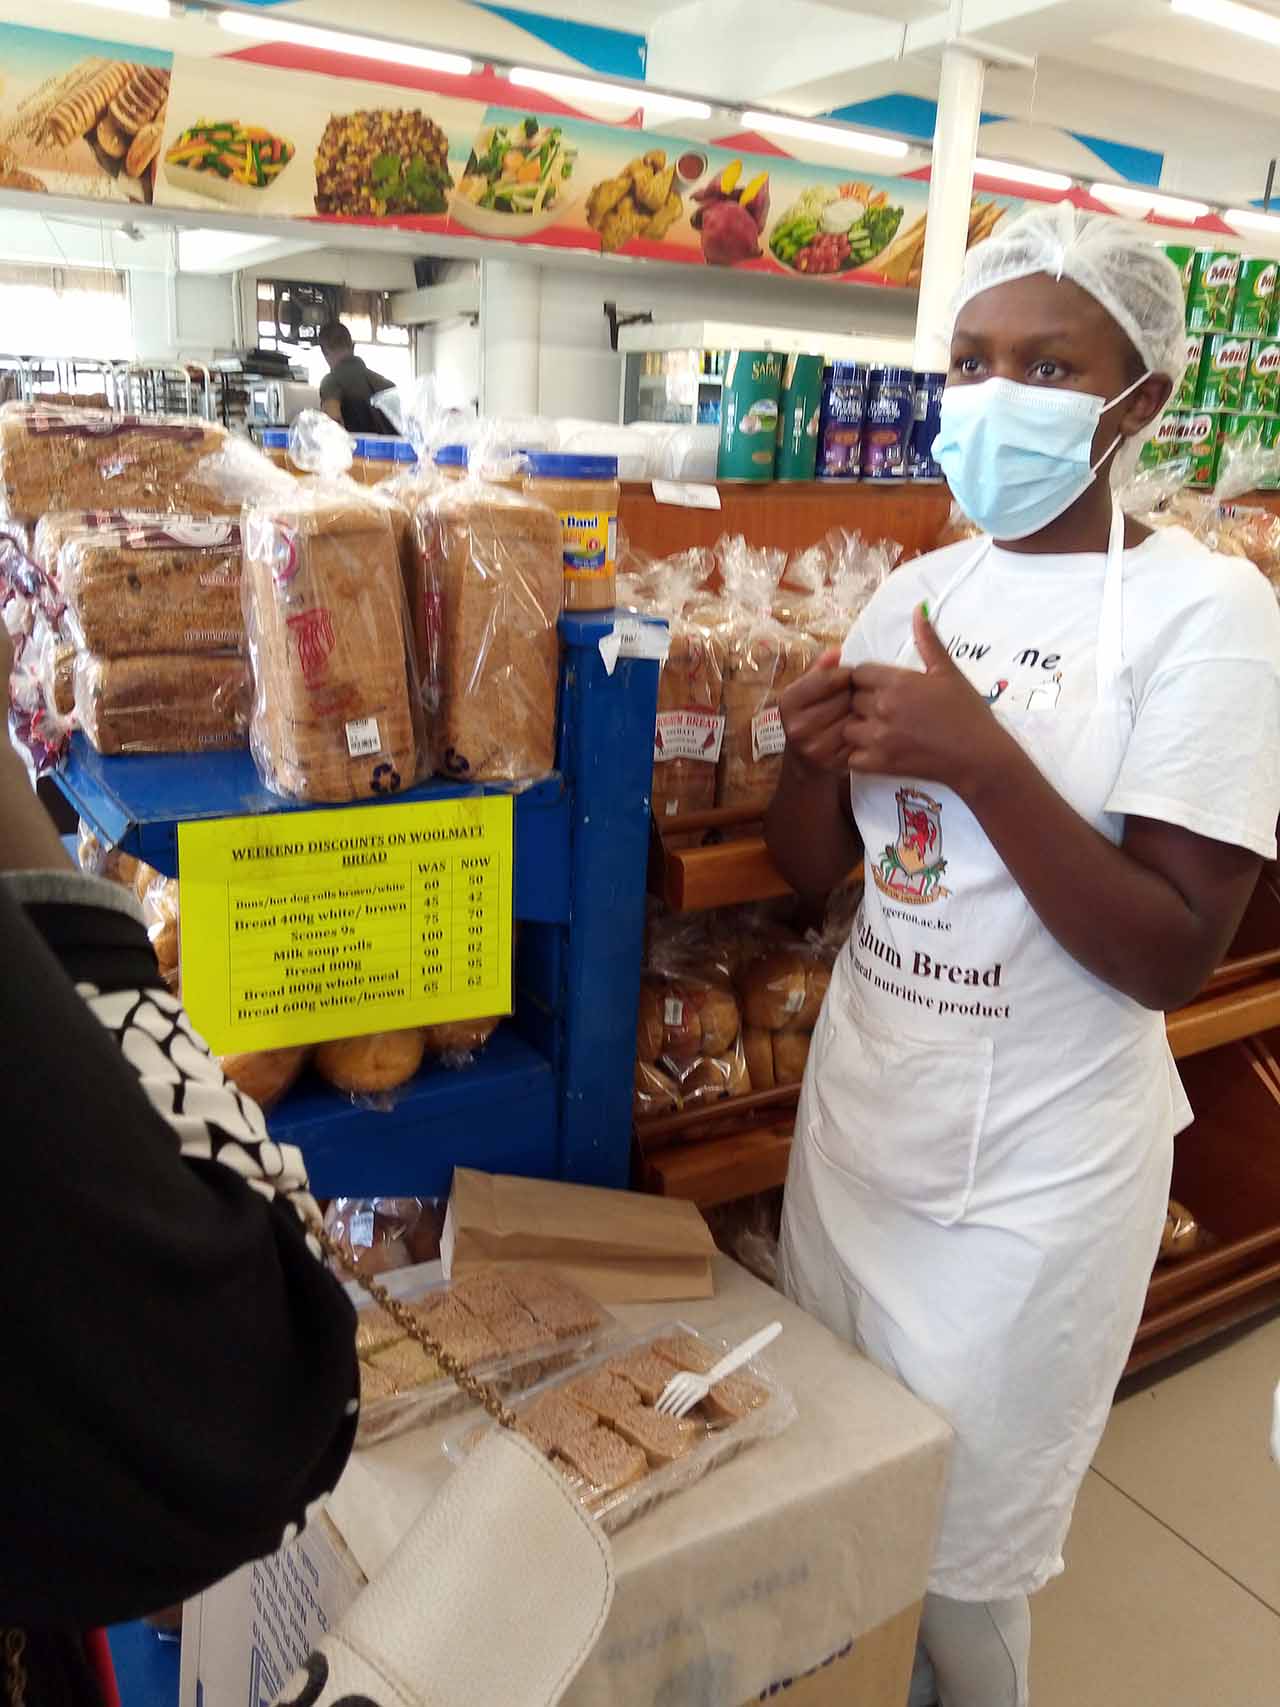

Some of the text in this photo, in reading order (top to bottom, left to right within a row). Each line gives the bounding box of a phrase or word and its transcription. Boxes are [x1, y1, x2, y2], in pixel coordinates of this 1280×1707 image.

[946, 634, 991, 660] llow
[232, 825, 485, 862] WEEKEND DISCOUNTS ON WOOLMATT
[342, 851, 388, 868] BREAD
[418, 856, 491, 874] WAS NOW
[235, 915, 277, 931] Bread
[280, 911, 315, 925] 400g
[365, 903, 407, 915] brown
[291, 928, 337, 942] Scones
[422, 930, 443, 942] 100
[274, 938, 372, 961] Milk soup rolls
[285, 962, 326, 979] Bread
[422, 963, 443, 976] 100
[912, 951, 1002, 988] Bread
[244, 986, 286, 1001] Bread
[326, 975, 365, 990] whole
[368, 969, 399, 984] meal
[873, 974, 935, 1009] nutritive
[938, 1000, 1011, 1019] product
[238, 988, 406, 1020] Bread 600g white/brown
